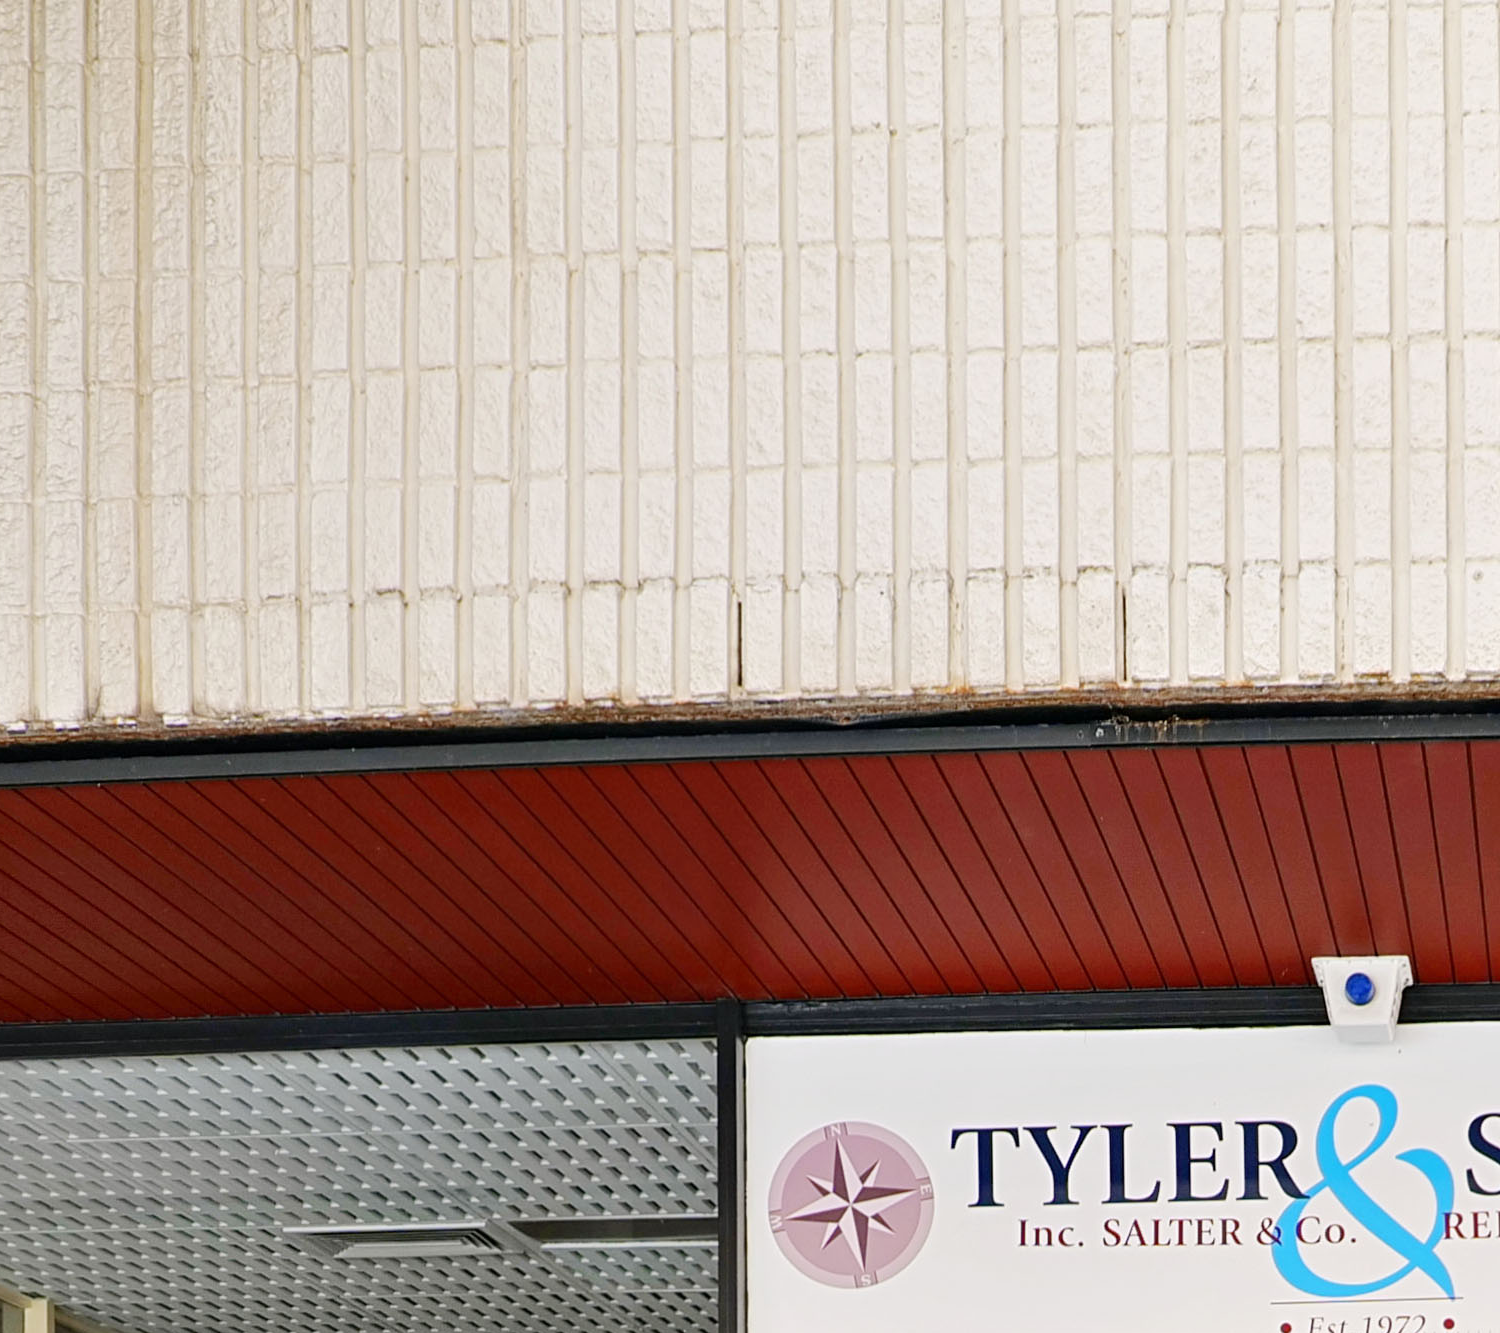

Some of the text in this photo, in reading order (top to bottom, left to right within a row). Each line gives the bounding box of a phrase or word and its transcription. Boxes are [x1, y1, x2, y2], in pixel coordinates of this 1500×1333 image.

[951, 1119, 1311, 1210] TYLER
[1270, 1083, 1455, 1300] &
[1017, 1217, 1085, 1249] Inc.
[1102, 1216, 1244, 1248] SALTER
[1256, 1216, 1282, 1246] &
[1295, 1214, 1357, 1246] Co.
